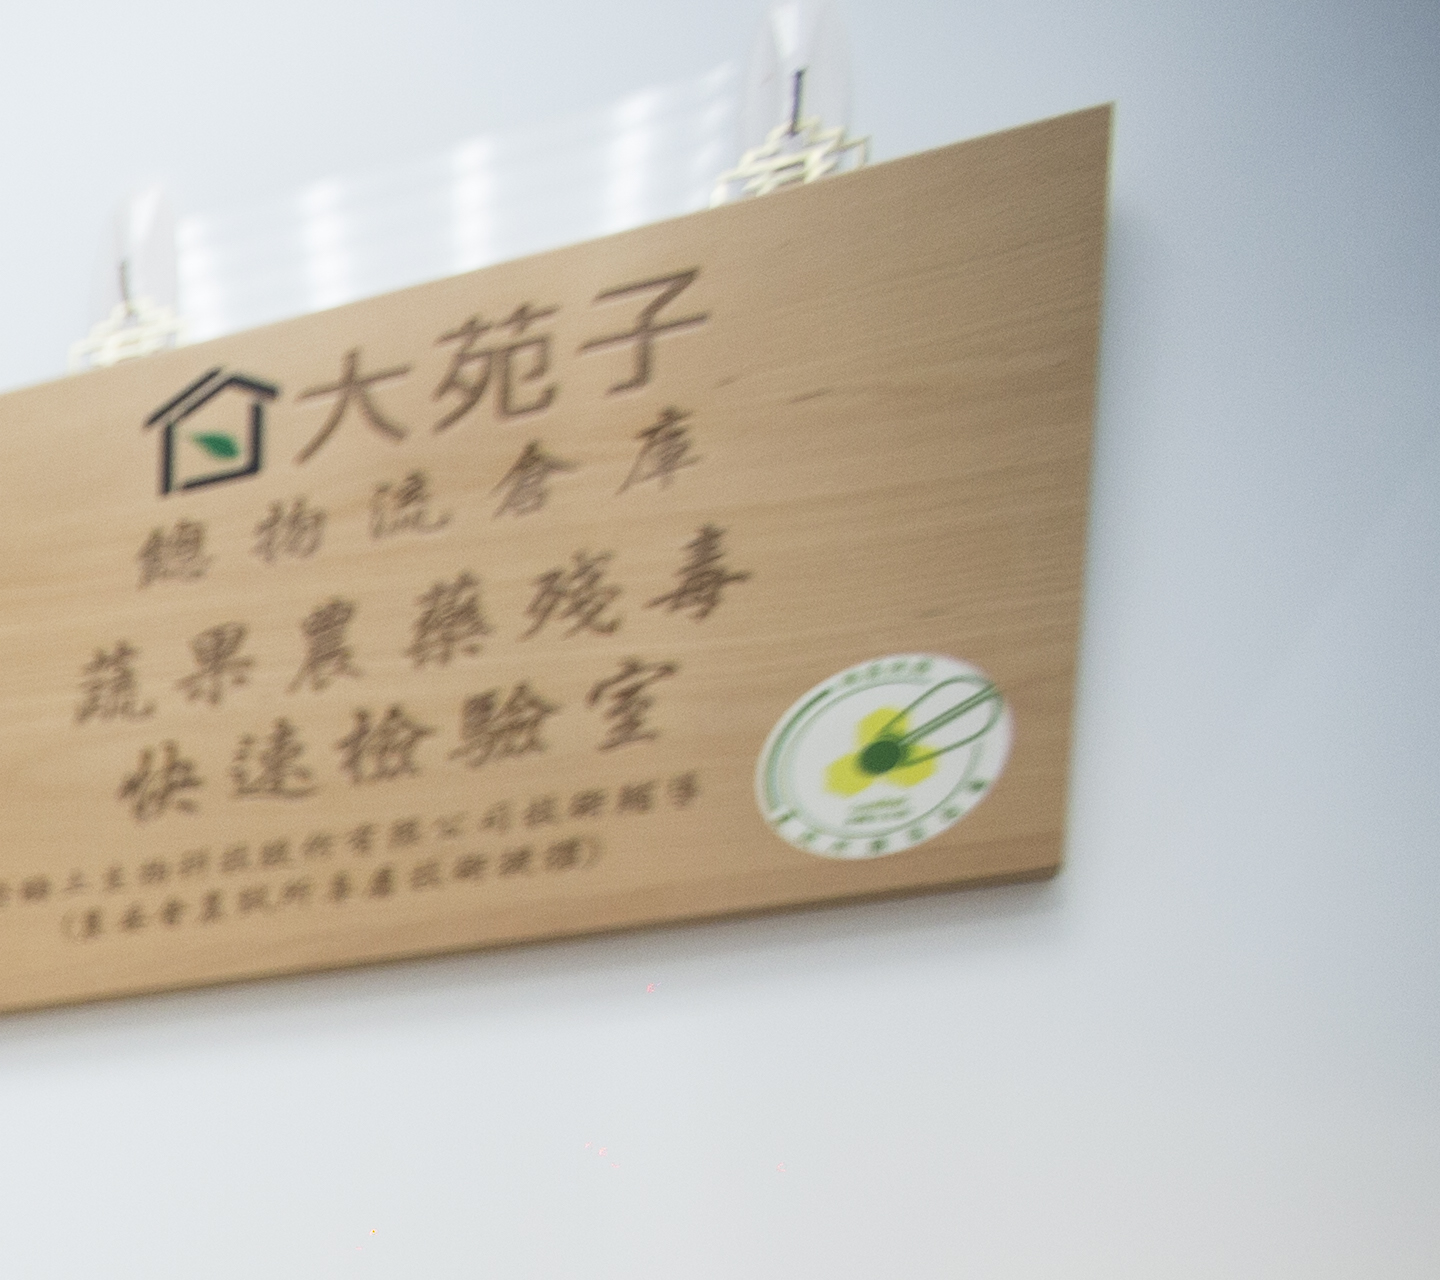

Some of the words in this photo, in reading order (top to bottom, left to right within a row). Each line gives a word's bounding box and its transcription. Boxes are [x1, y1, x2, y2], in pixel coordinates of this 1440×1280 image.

[294, 266, 711, 464] 大苑子
[135, 405, 703, 591] 總物流倉庫
[72, 522, 754, 727] 蔬果農藥殘毒
[118, 656, 680, 825] 快速檢驗室
